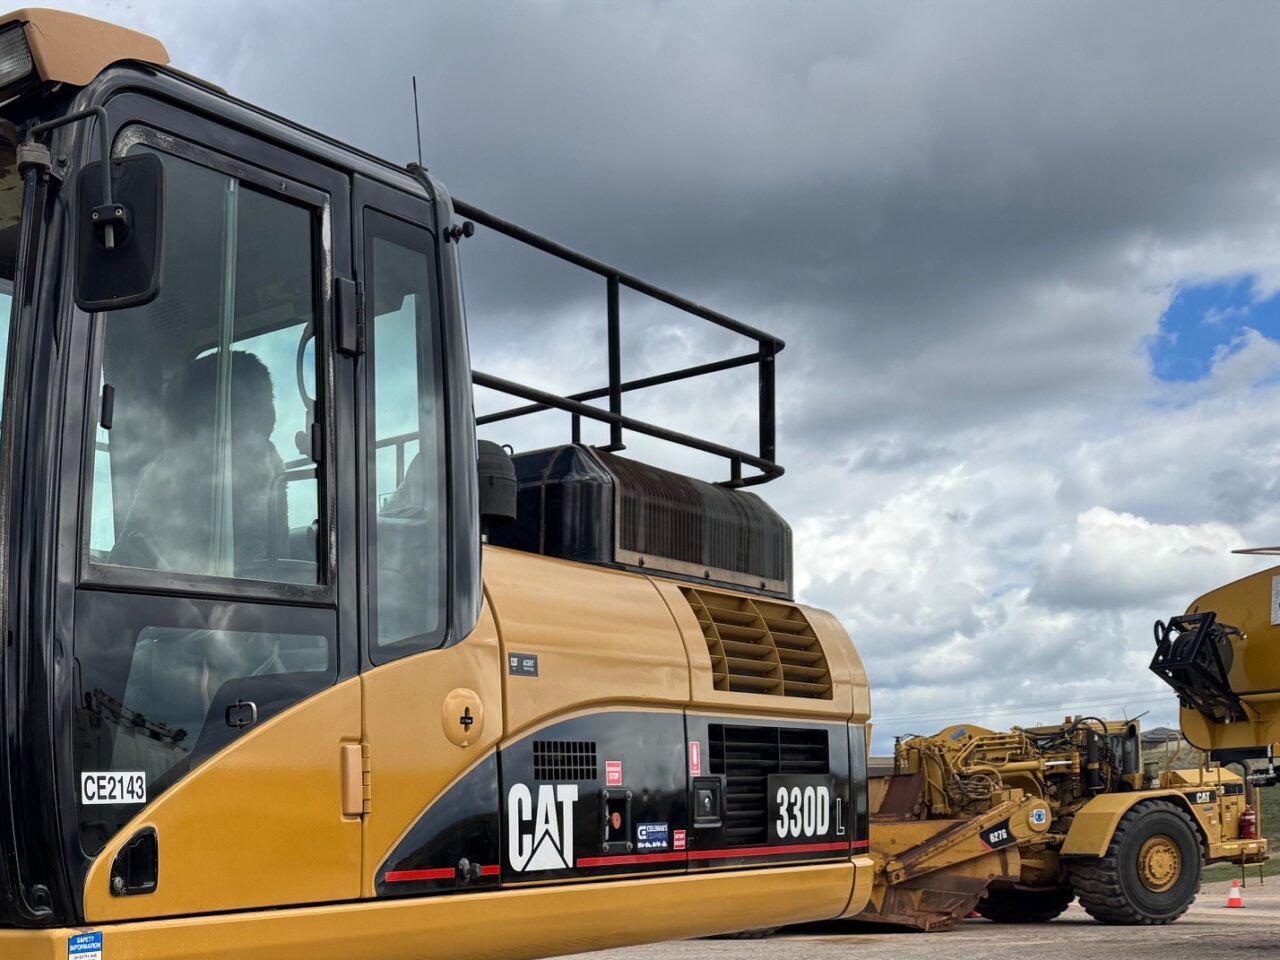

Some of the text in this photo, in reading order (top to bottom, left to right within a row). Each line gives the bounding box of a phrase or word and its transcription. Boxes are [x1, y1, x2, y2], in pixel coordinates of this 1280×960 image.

[83, 775, 145, 801] CE2143
[1196, 791, 1211, 803] CAT
[775, 785, 845, 838] 330D L
[507, 783, 579, 872] CAT
[989, 829, 1008, 843] 627G
[70, 943, 101, 951] INFORMATION
